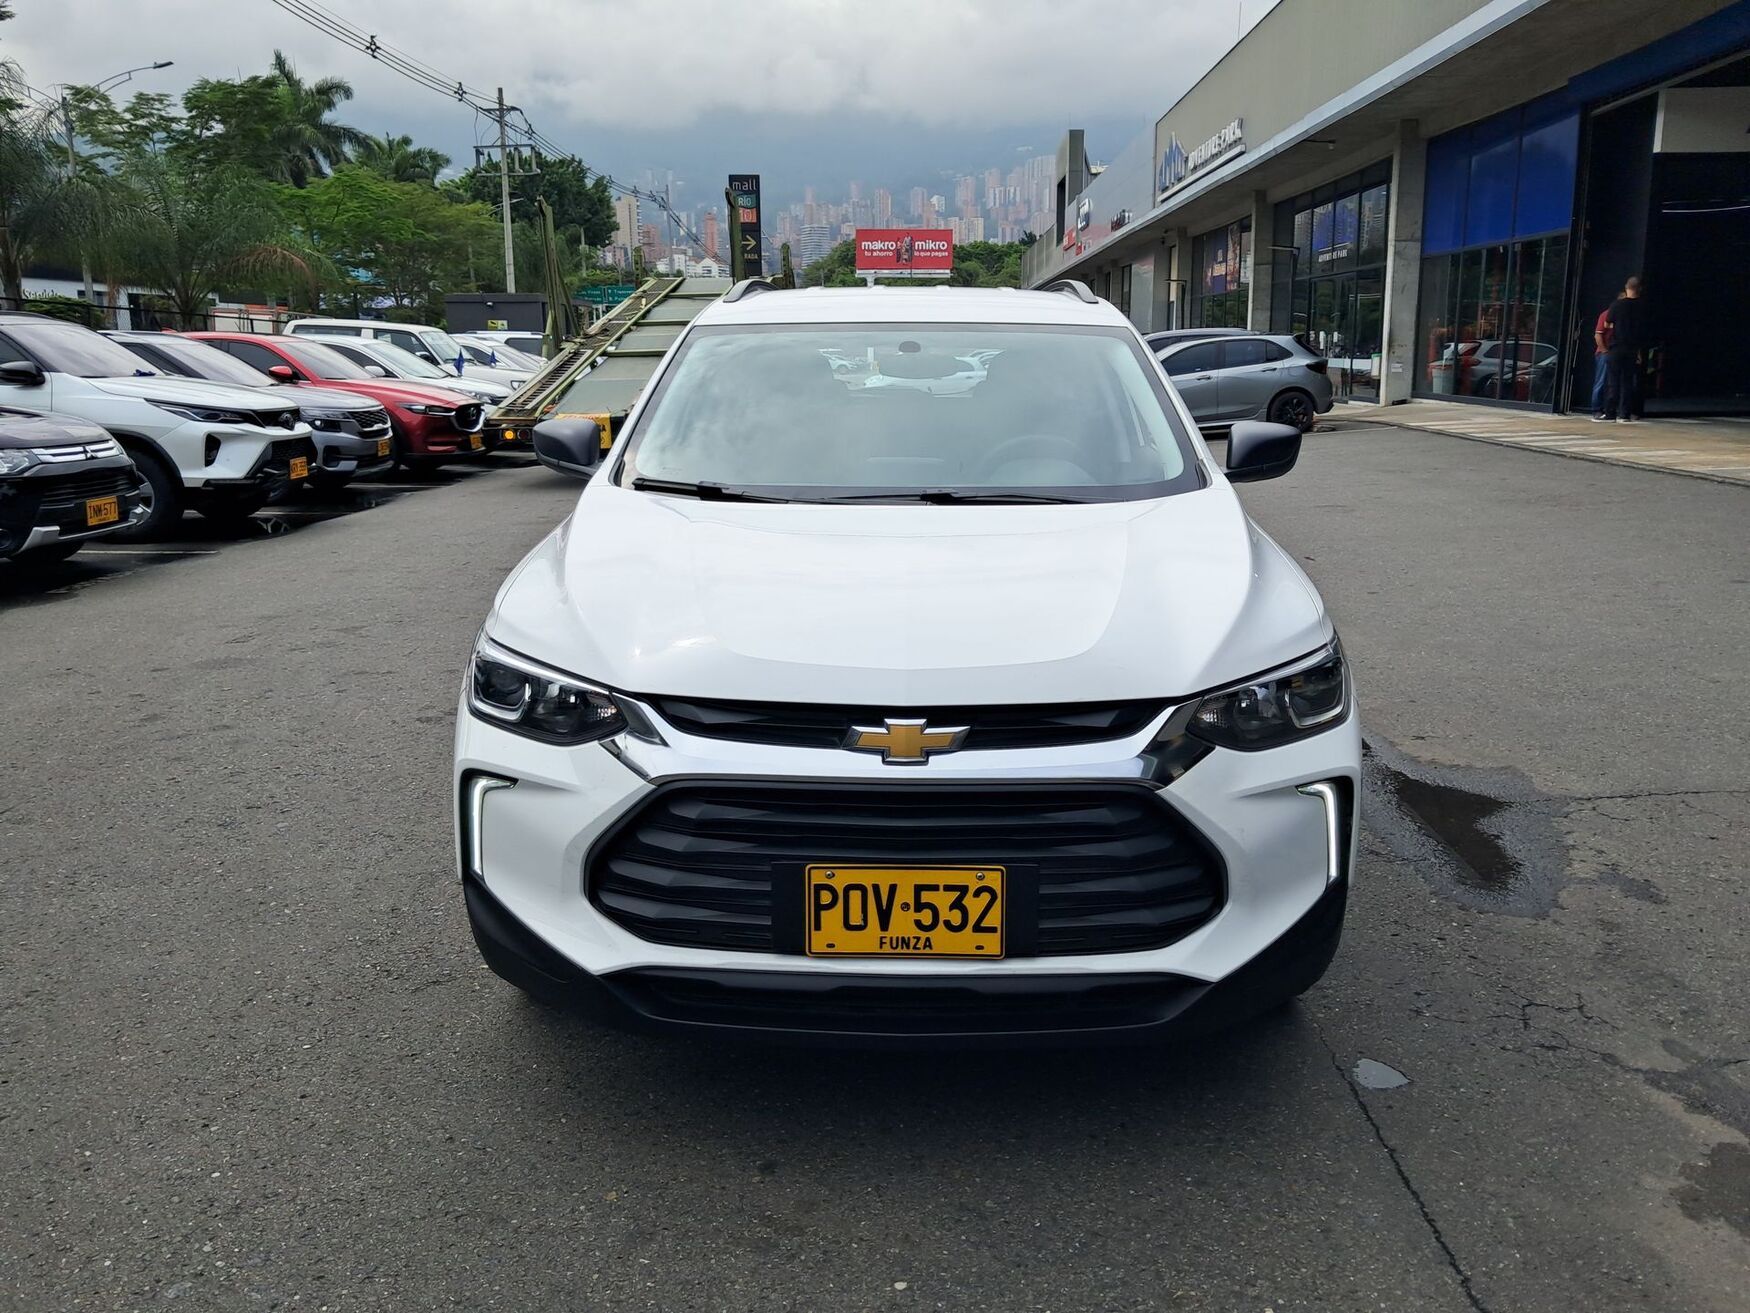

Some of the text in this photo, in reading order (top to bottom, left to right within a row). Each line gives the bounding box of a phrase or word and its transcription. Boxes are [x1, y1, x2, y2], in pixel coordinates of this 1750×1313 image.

[732, 178, 756, 190] mall
[861, 239, 896, 250] makro
[915, 239, 948, 250] mikro
[879, 935, 933, 951] FUNZA
